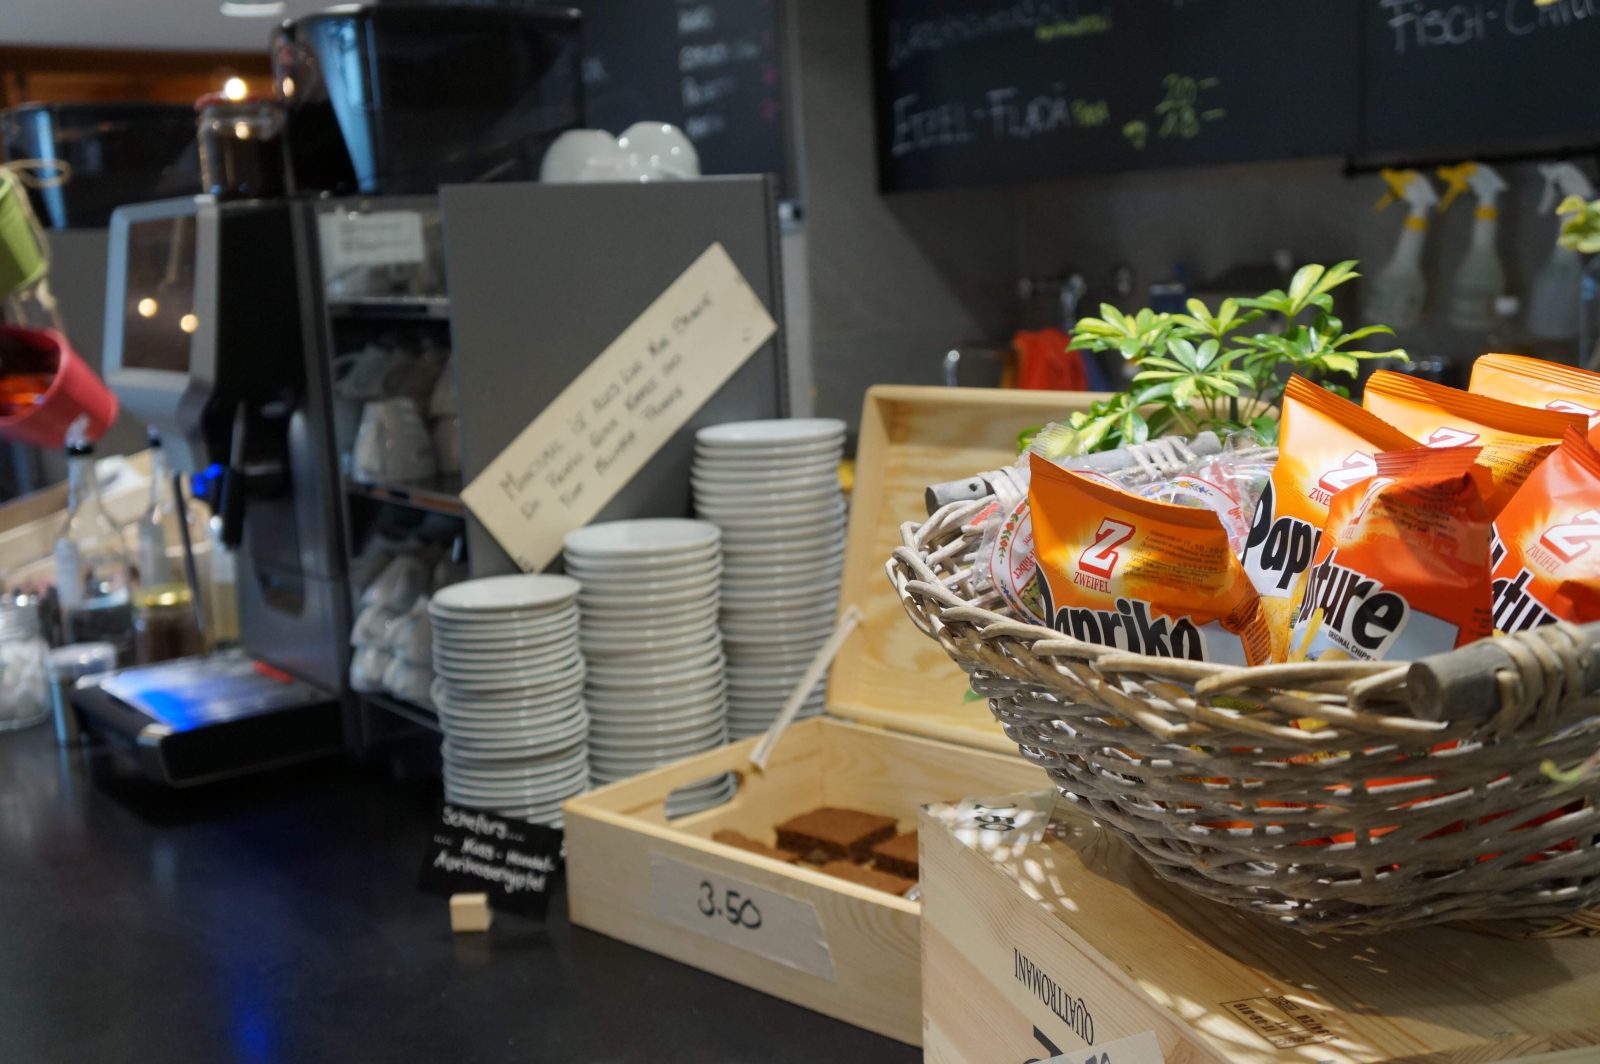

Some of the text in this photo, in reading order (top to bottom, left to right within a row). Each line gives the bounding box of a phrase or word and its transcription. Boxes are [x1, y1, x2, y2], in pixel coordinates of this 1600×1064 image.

[1078, 517, 1137, 580] Z
[1526, 544, 1562, 575] ZWEIFEL
[1073, 571, 1112, 595] ZWEIFEL
[1328, 630, 1350, 650] ORIGINAL
[696, 881, 763, 930] 3.50
[1014, 947, 1094, 1046] QUATTROMANI
